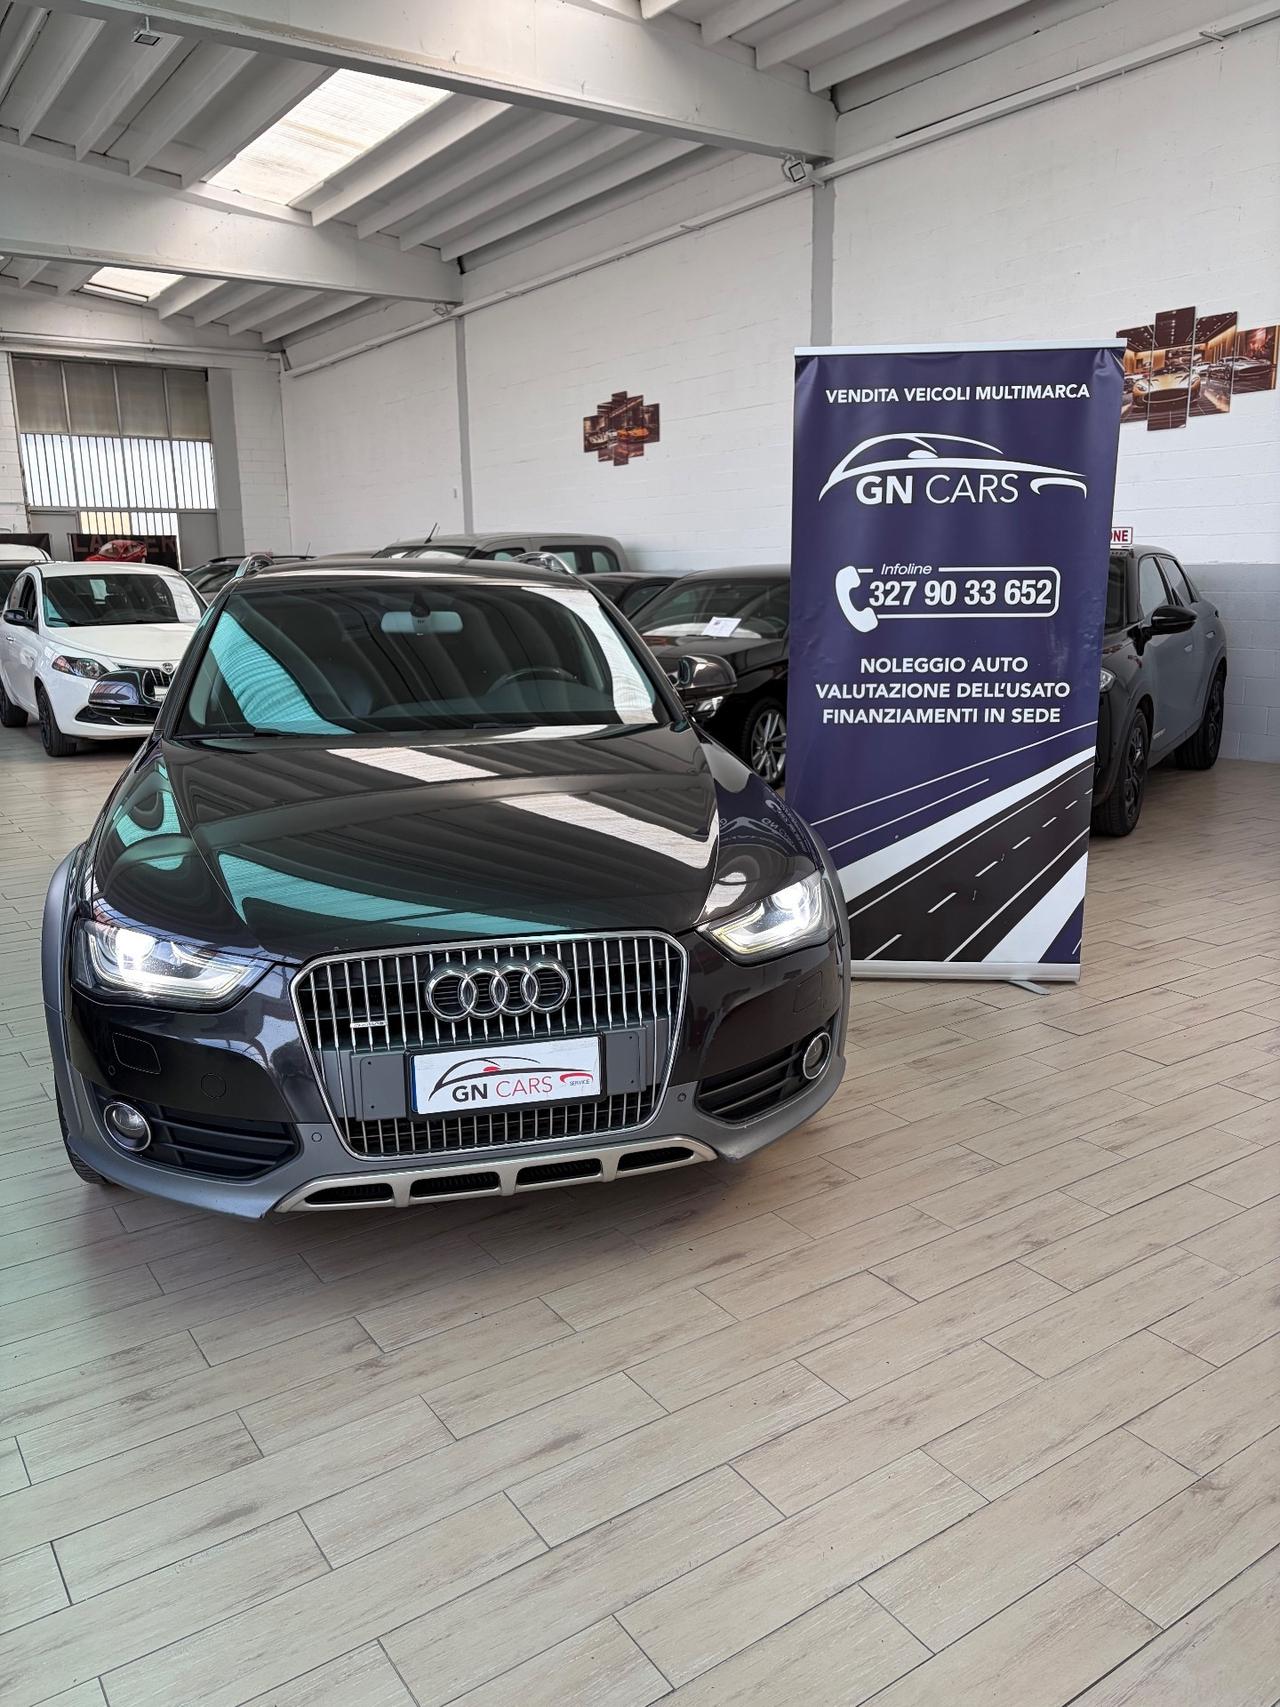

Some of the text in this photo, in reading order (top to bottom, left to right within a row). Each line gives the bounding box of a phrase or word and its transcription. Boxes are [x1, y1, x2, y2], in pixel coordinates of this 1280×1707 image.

[826, 384, 1090, 403] VENDITA VEICOLI MULTIMARCA
[856, 474, 1018, 505] GN CARS
[1110, 530, 1129, 542] NE
[881, 563, 932, 574] Infoline
[869, 580, 1051, 606] 327 90 33 652
[861, 657, 1028, 673] NOLEGGIO AUTO
[816, 684, 950, 698] VALUTAZIONE
[823, 708, 1060, 723] FINANZIAMENTI IN SEDE
[452, 1076, 553, 1102] GN CARS
